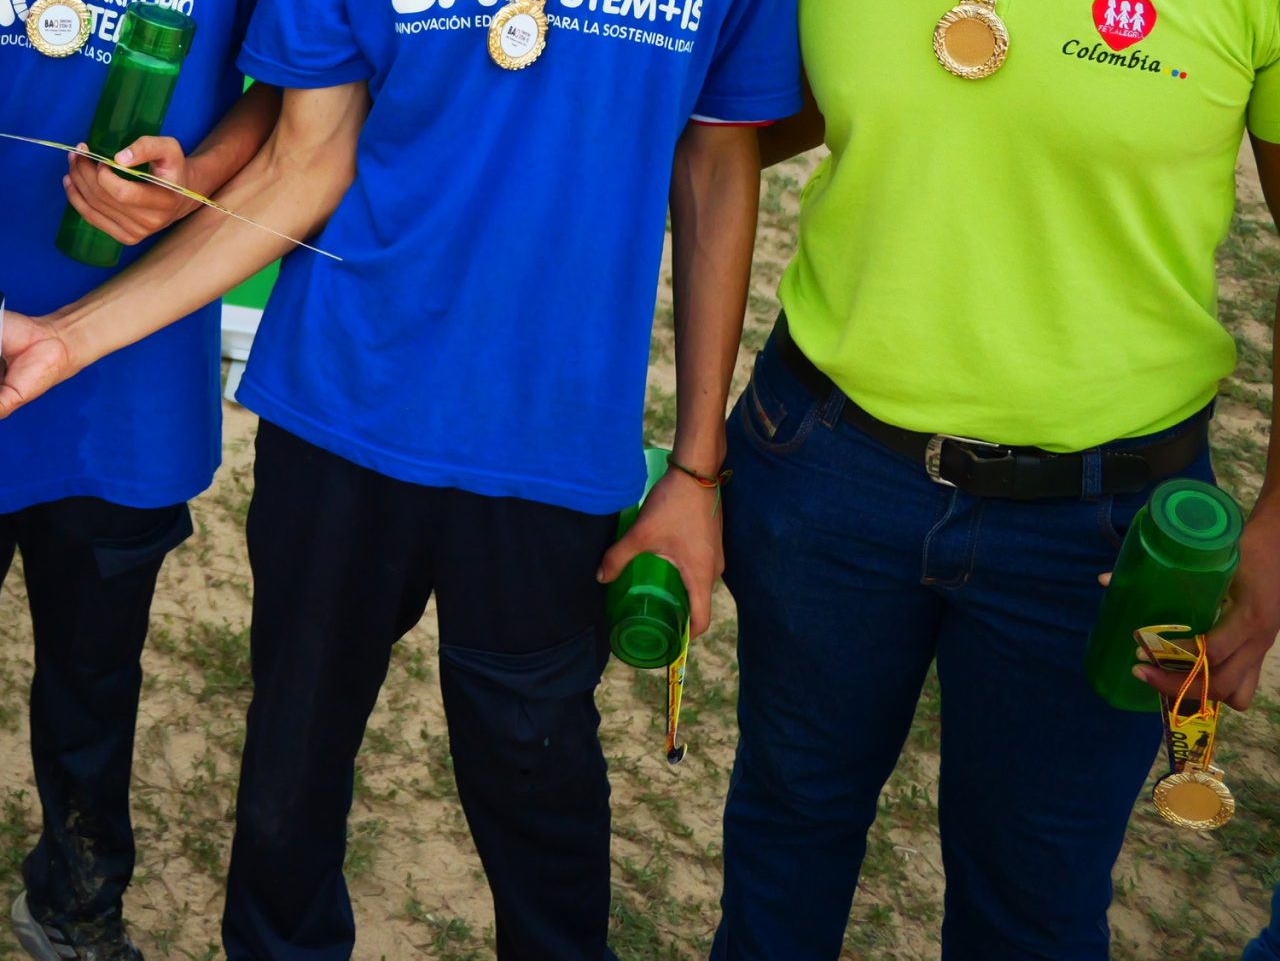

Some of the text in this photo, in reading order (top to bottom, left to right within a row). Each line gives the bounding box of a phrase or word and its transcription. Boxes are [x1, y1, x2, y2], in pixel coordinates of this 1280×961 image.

[547, 14, 579, 32] PARA
[583, 22, 600, 36] LA
[84, 44, 96, 59] LA
[1062, 39, 1161, 73] Colombia
